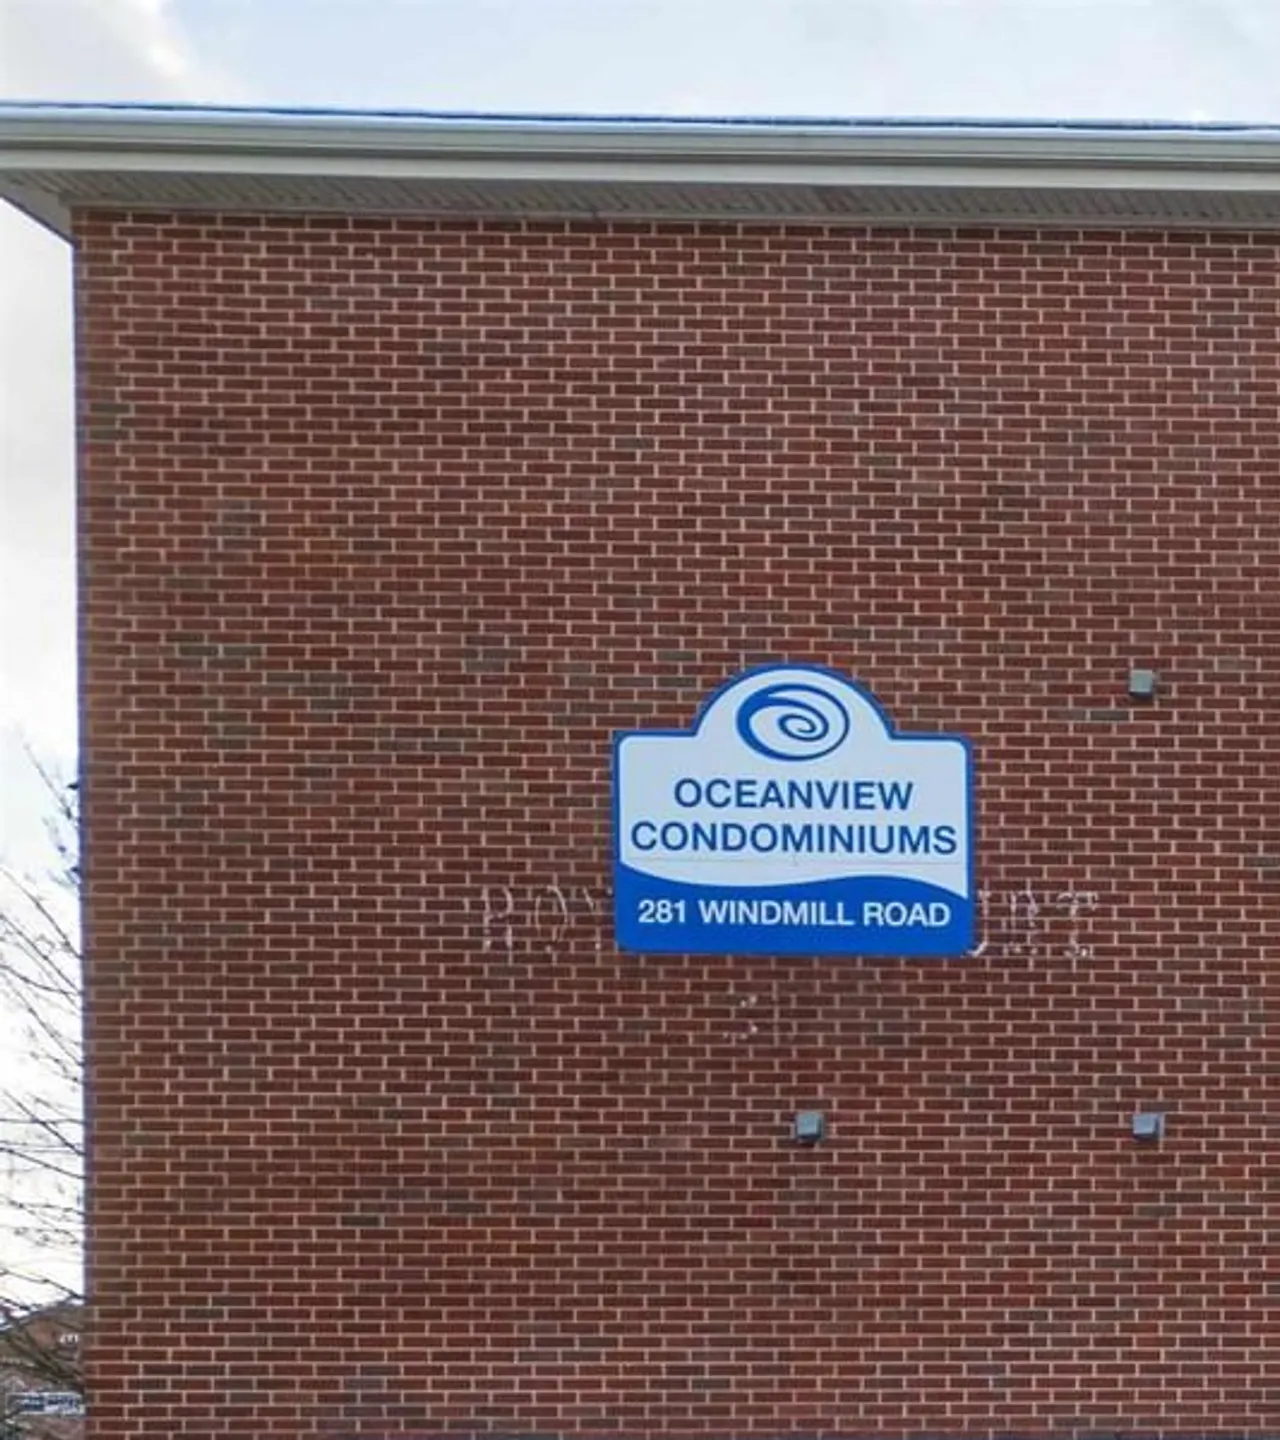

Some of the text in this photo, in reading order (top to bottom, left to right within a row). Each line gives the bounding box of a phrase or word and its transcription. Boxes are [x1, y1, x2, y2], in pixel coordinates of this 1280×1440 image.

[673, 777, 913, 811] OCEANVIEW
[630, 820, 957, 855] CONDOMINIUMS
[637, 899, 950, 927] 281 WINDMILL ROAD
